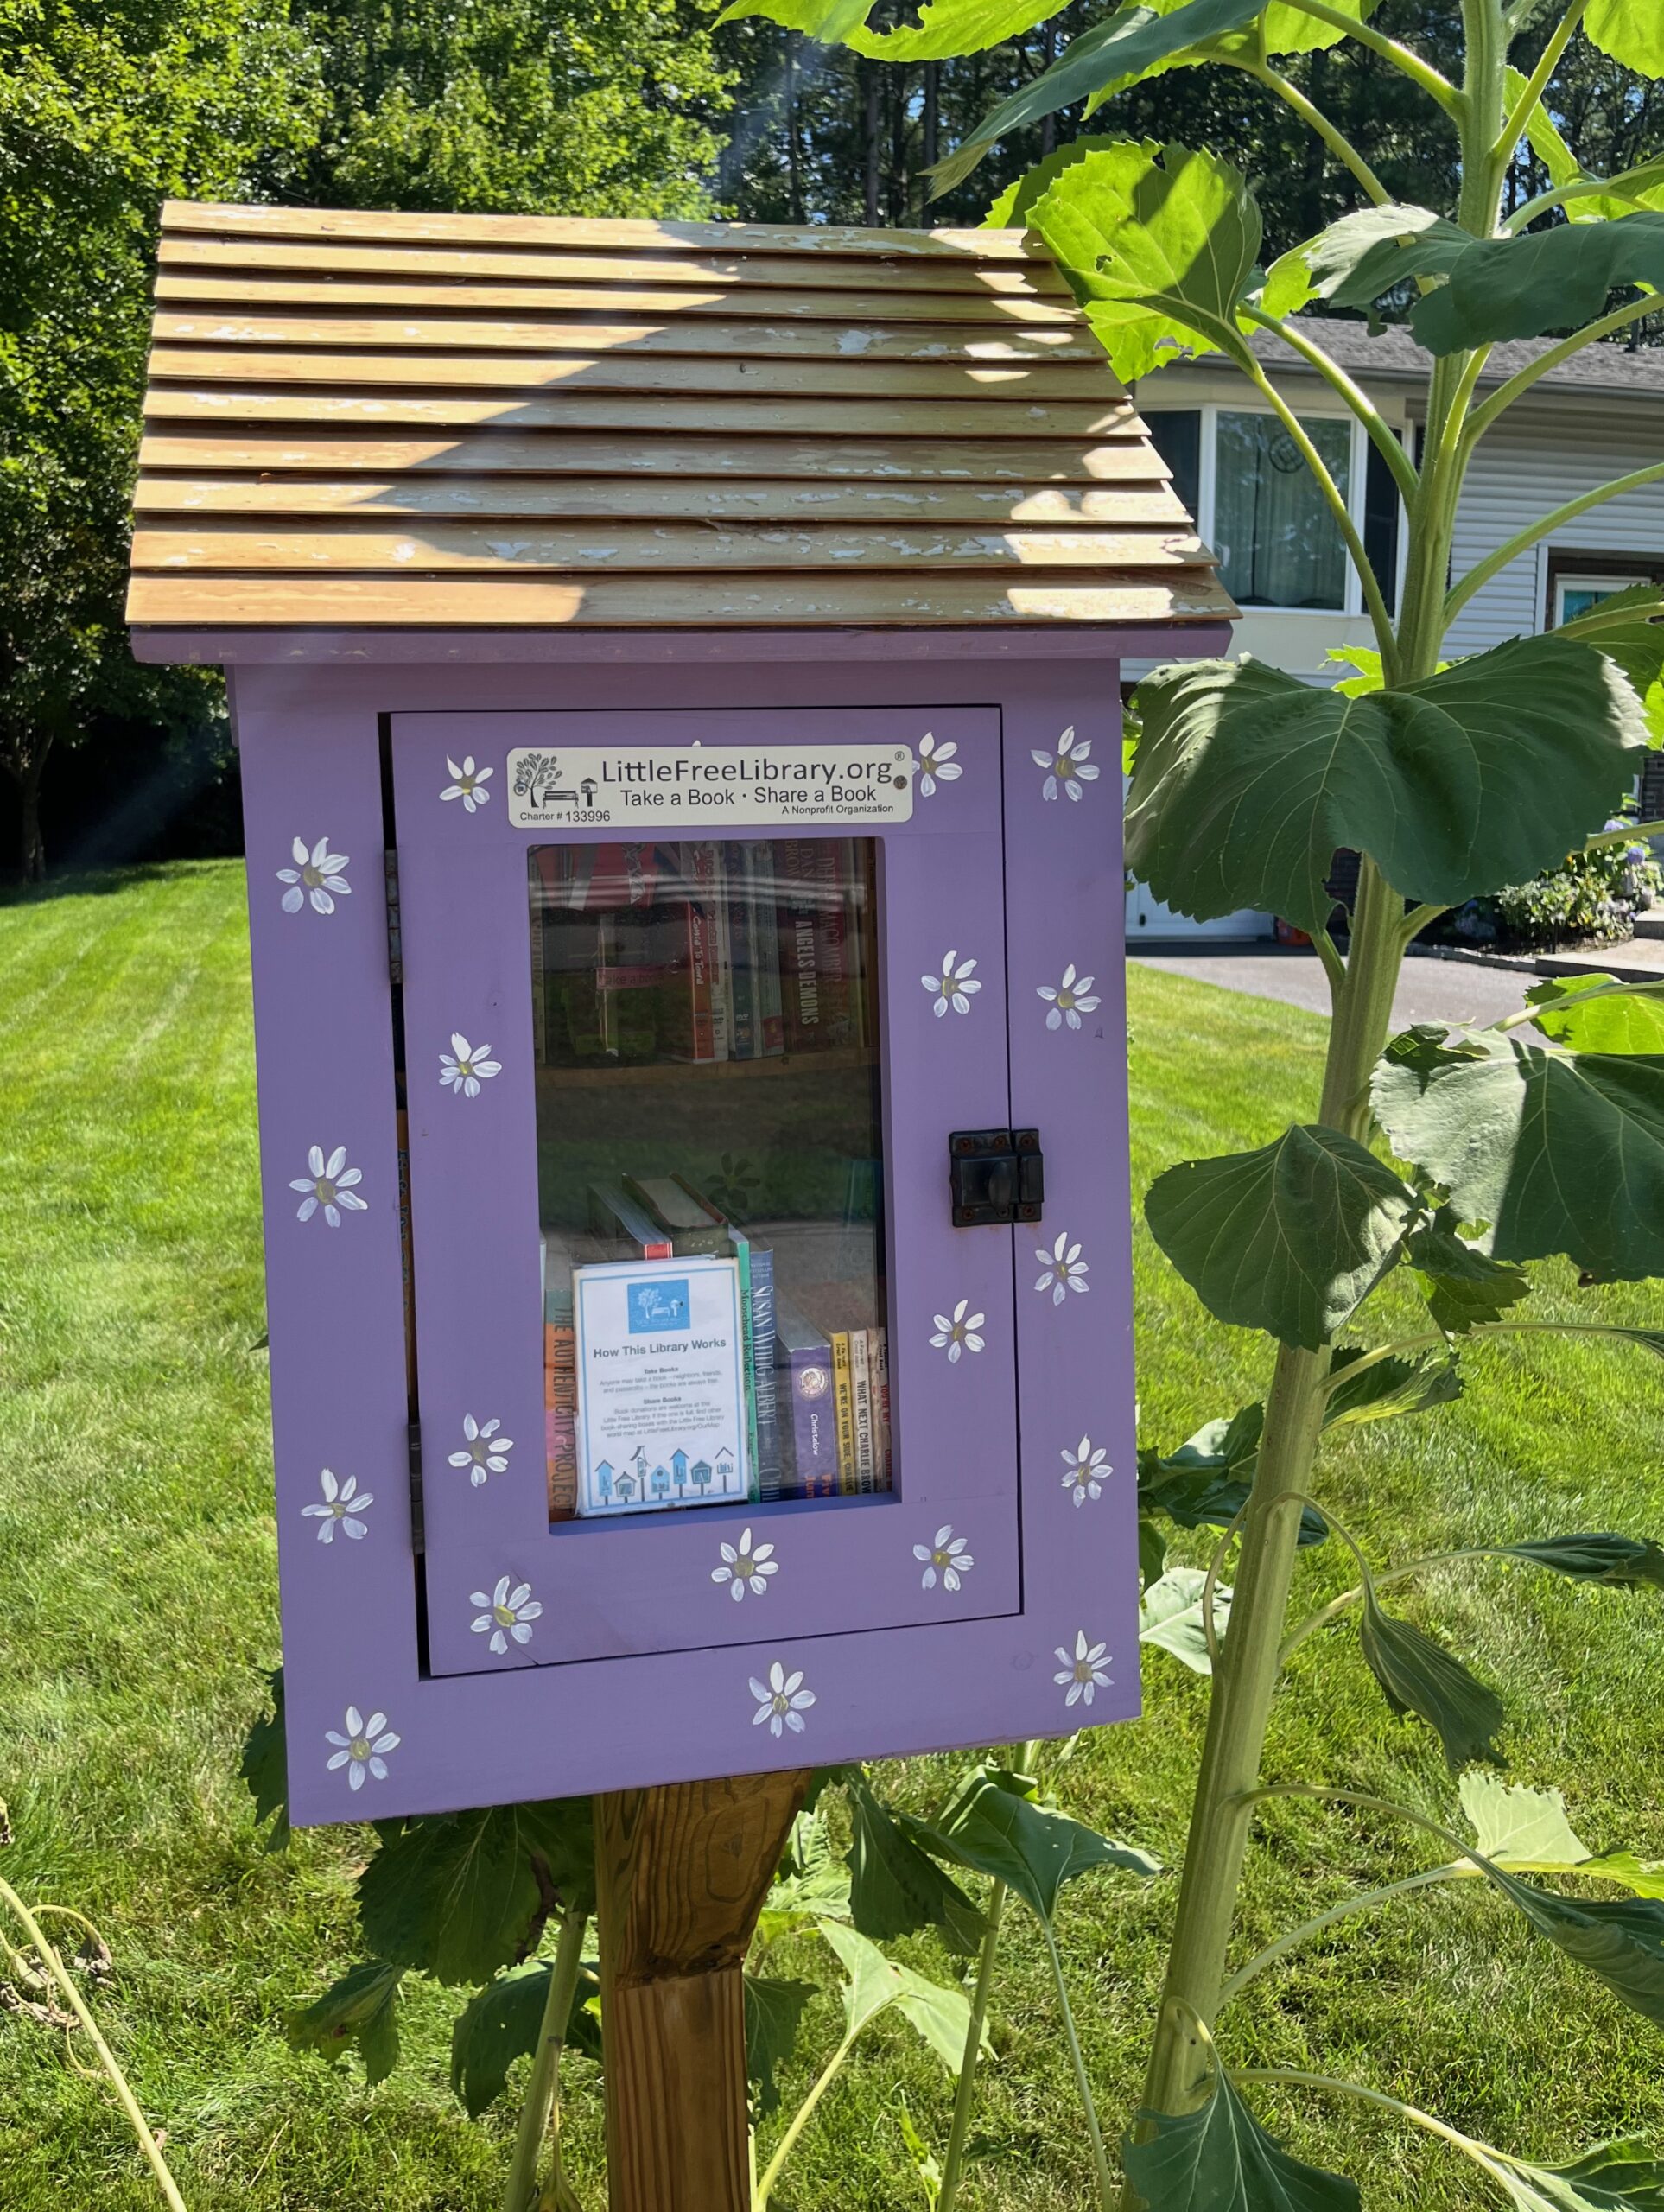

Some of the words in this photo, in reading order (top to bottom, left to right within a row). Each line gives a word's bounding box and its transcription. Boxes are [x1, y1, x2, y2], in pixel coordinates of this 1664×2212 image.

[602, 759, 892, 785] LittleFreeLibrary.org
[620, 790, 664, 806] Take
[670, 792, 681, 805] a
[689, 788, 735, 805] Book
[754, 786, 808, 804] Share
[814, 788, 824, 803] a
[831, 785, 876, 803] Book
[782, 805, 790, 814] A
[792, 805, 834, 816] Nonprofit
[836, 804, 894, 815] Organization
[520, 812, 555, 821] Charter
[566, 810, 611, 822] 133996
[801, 848, 814, 878] DAN
[795, 920, 816, 969] ANGELS
[798, 970, 820, 1025] DEMONS
[554, 1307, 574, 1332] THE
[740, 1289, 751, 1341] Moosehead
[752, 1286, 774, 1328] SUSAN
[594, 1348, 619, 1358] How
[622, 1345, 646, 1356] This
[649, 1342, 689, 1353] Library
[691, 1338, 727, 1350] Works
[753, 1330, 776, 1376] WITTIG
[553, 1339, 576, 1434] AUTHENTICITY
[839, 1382, 848, 1405] WE'RE
[857, 1380, 867, 1404] WHAT
[755, 1380, 777, 1425] ALBERT
[840, 1408, 848, 1418] ON
[810, 1413, 820, 1456] Christelow
[841, 1421, 849, 1440] YOUR
[859, 1432, 870, 1467] CHARLIE
[844, 1462, 854, 1491] CHARLIE
